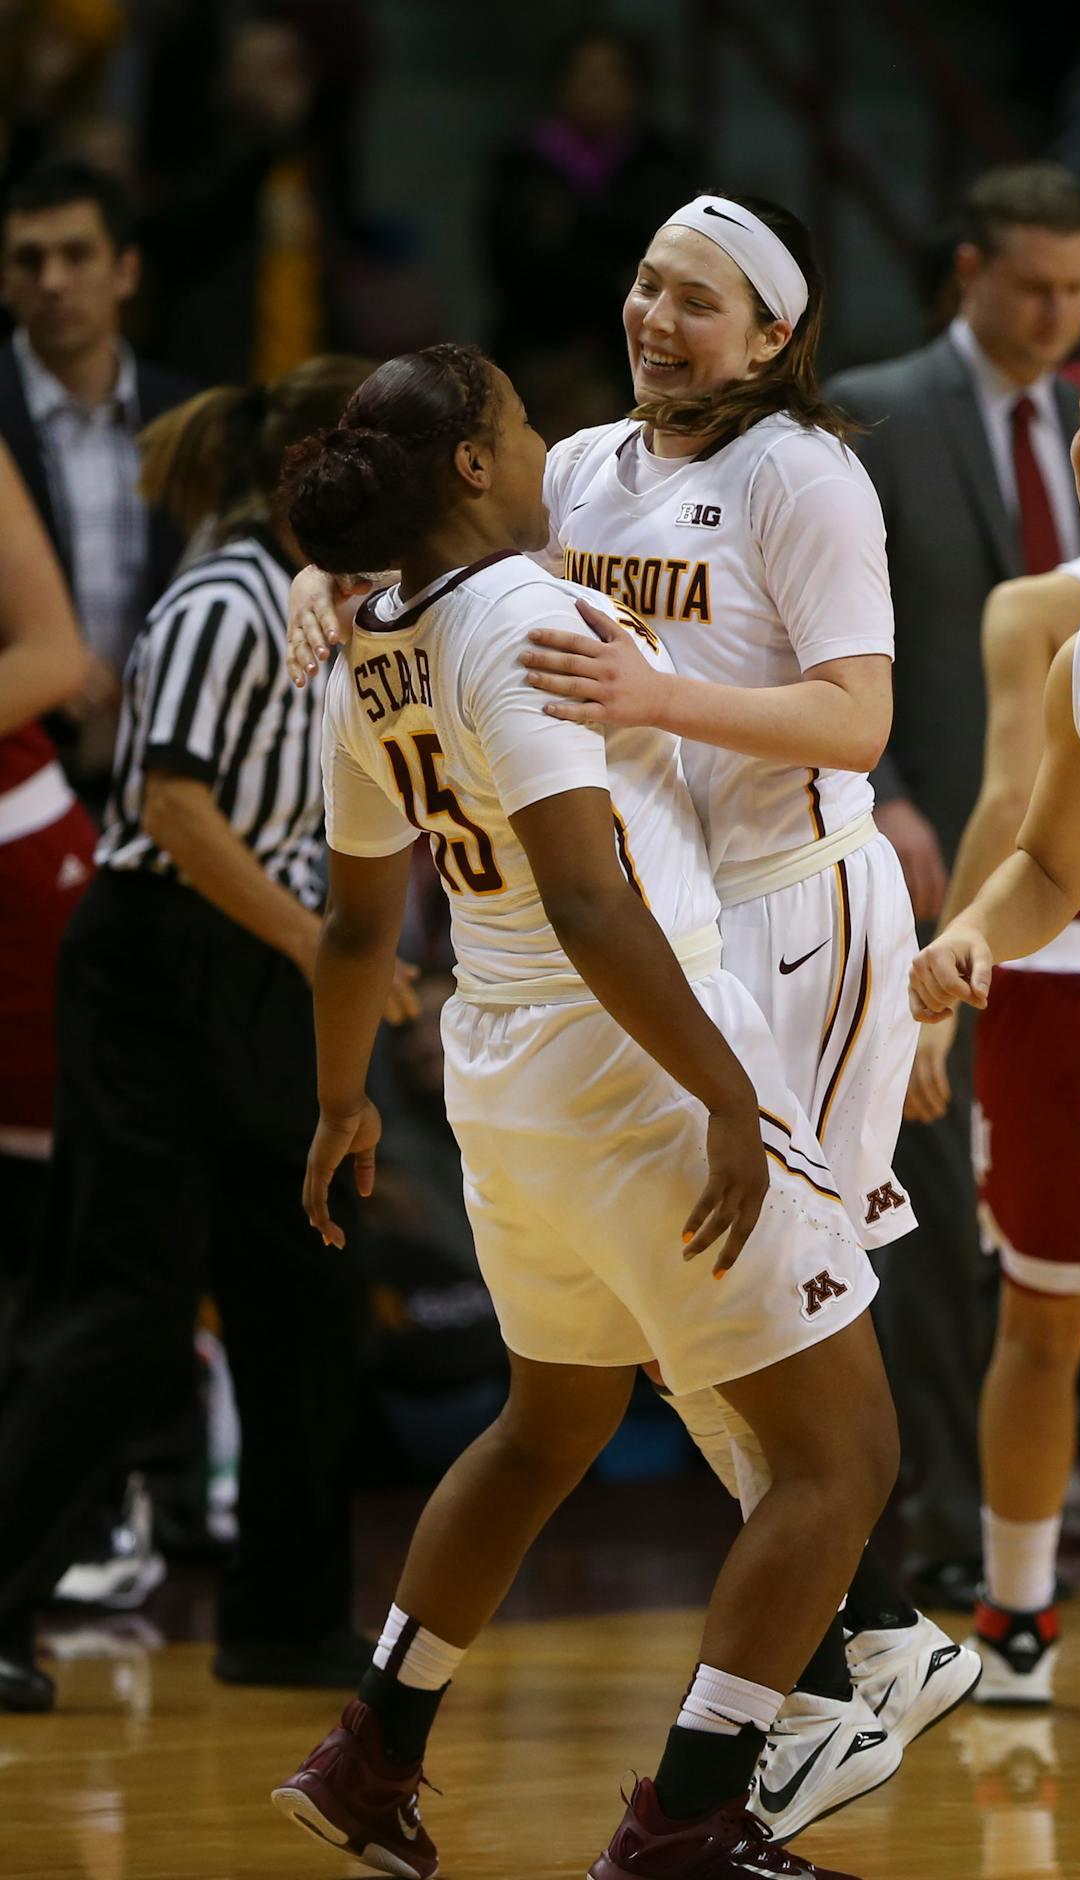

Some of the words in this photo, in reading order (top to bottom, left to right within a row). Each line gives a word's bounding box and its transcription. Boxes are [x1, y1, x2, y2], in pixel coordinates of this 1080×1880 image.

[564, 547, 713, 624] INNESOTA
[380, 730, 507, 897] 15
[866, 1181, 905, 1224] M
[802, 1270, 848, 1315] M
